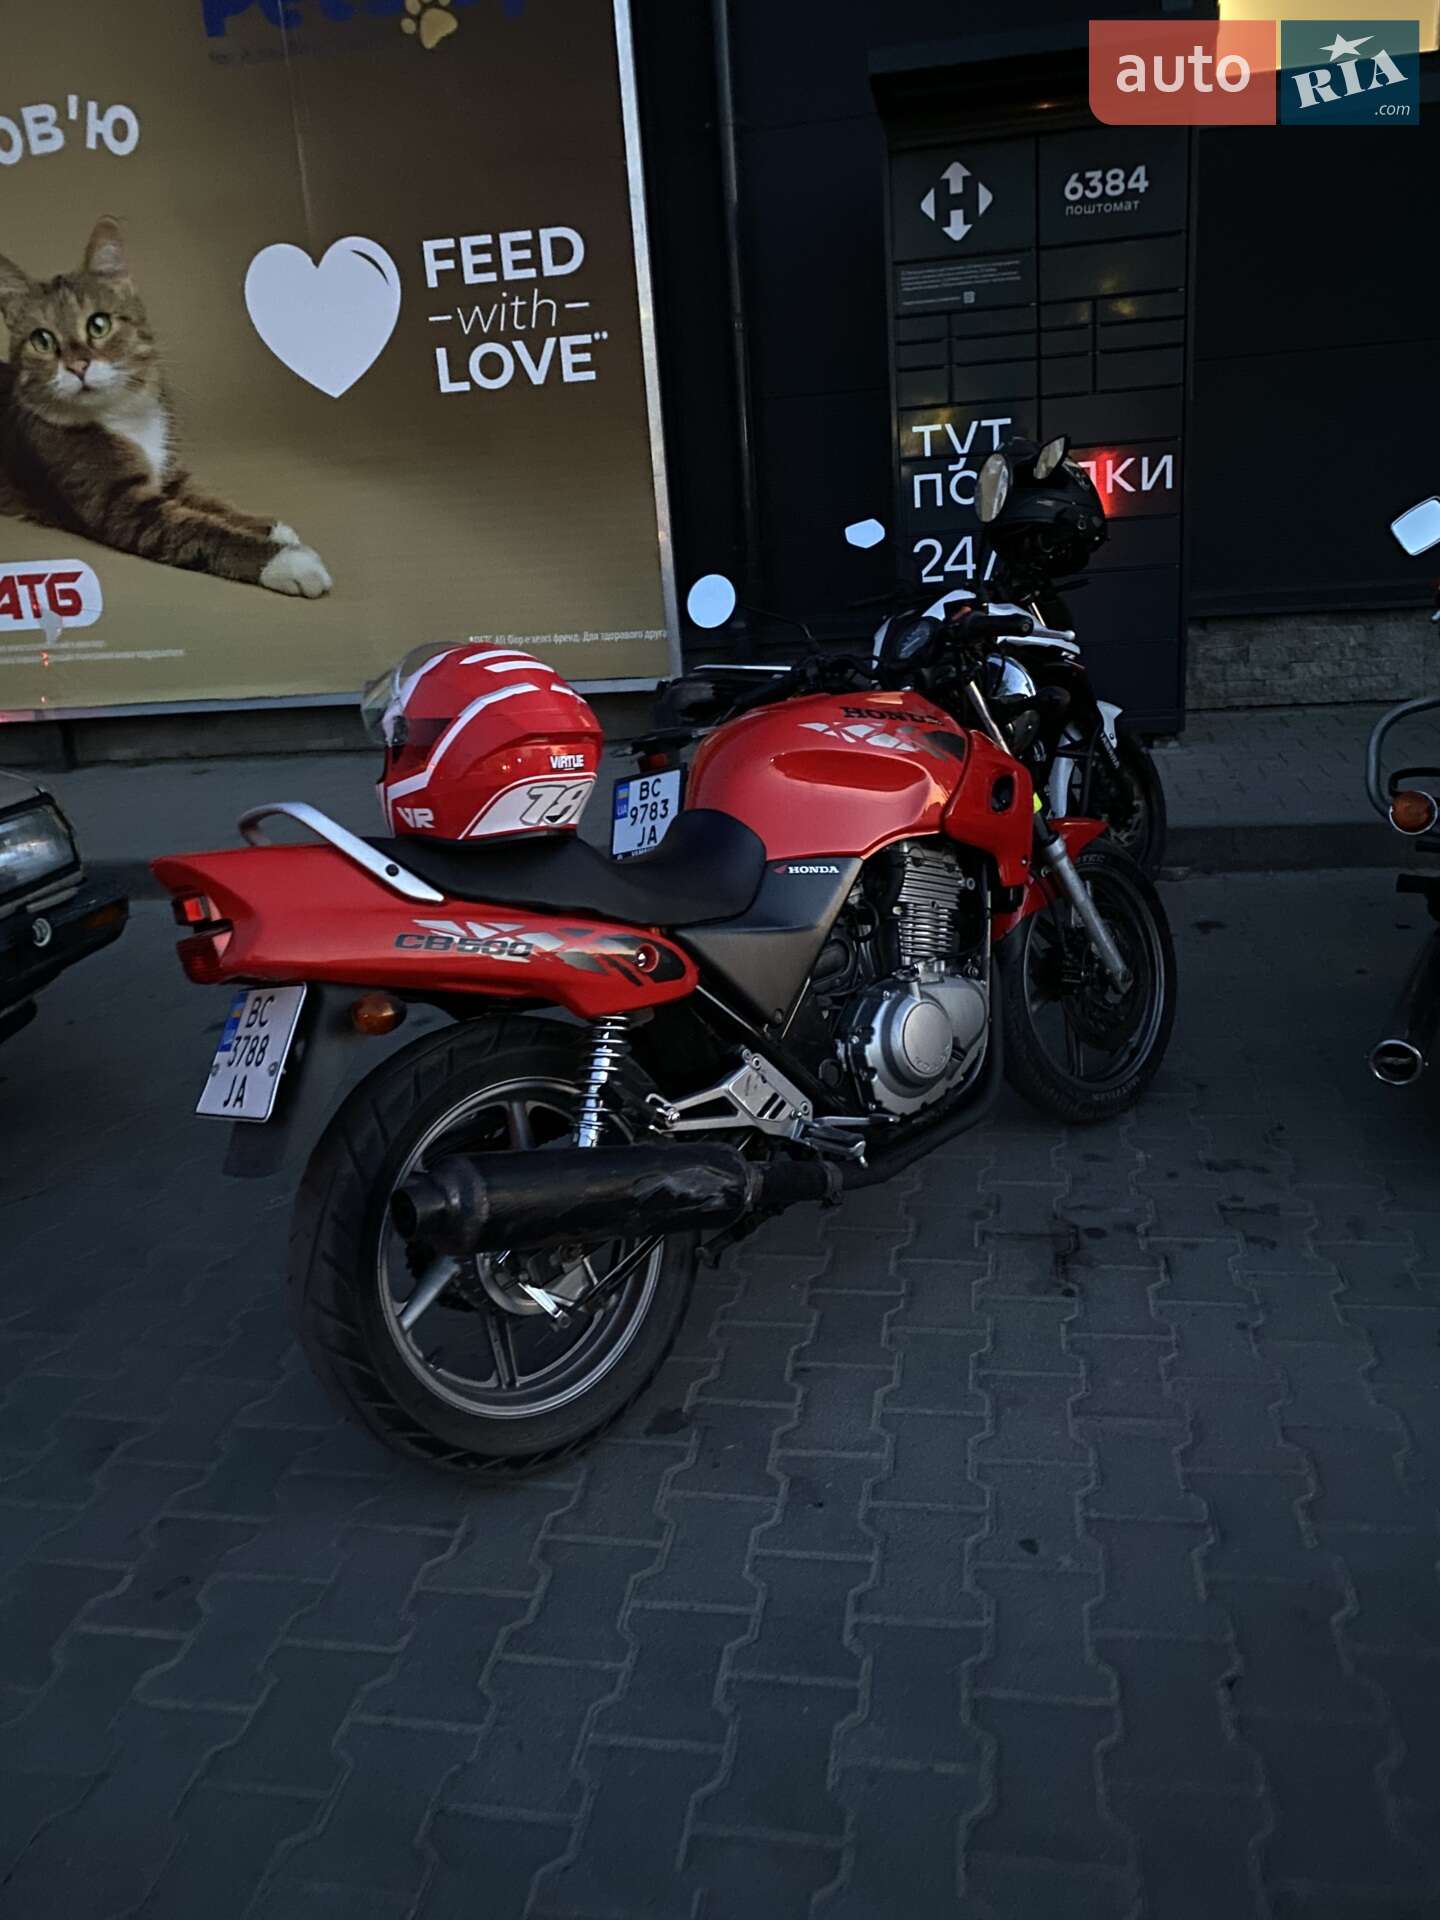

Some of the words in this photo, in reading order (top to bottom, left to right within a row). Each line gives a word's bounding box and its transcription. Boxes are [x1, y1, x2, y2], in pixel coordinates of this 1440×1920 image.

[1064, 164, 1149, 201] 6384
[1065, 200, 1140, 216] поштомат
[422, 226, 585, 288] FEED
[912, 535, 998, 583] 24/
[549, 754, 584, 769] VIRTUE
[640, 778, 661, 800] BC
[630, 798, 669, 826] 9783
[637, 825, 657, 847] JA
[788, 865, 840, 874] HONDA
[246, 995, 274, 1028] BC
[227, 1034, 270, 1067] 3788
[223, 1074, 247, 1108] JA
